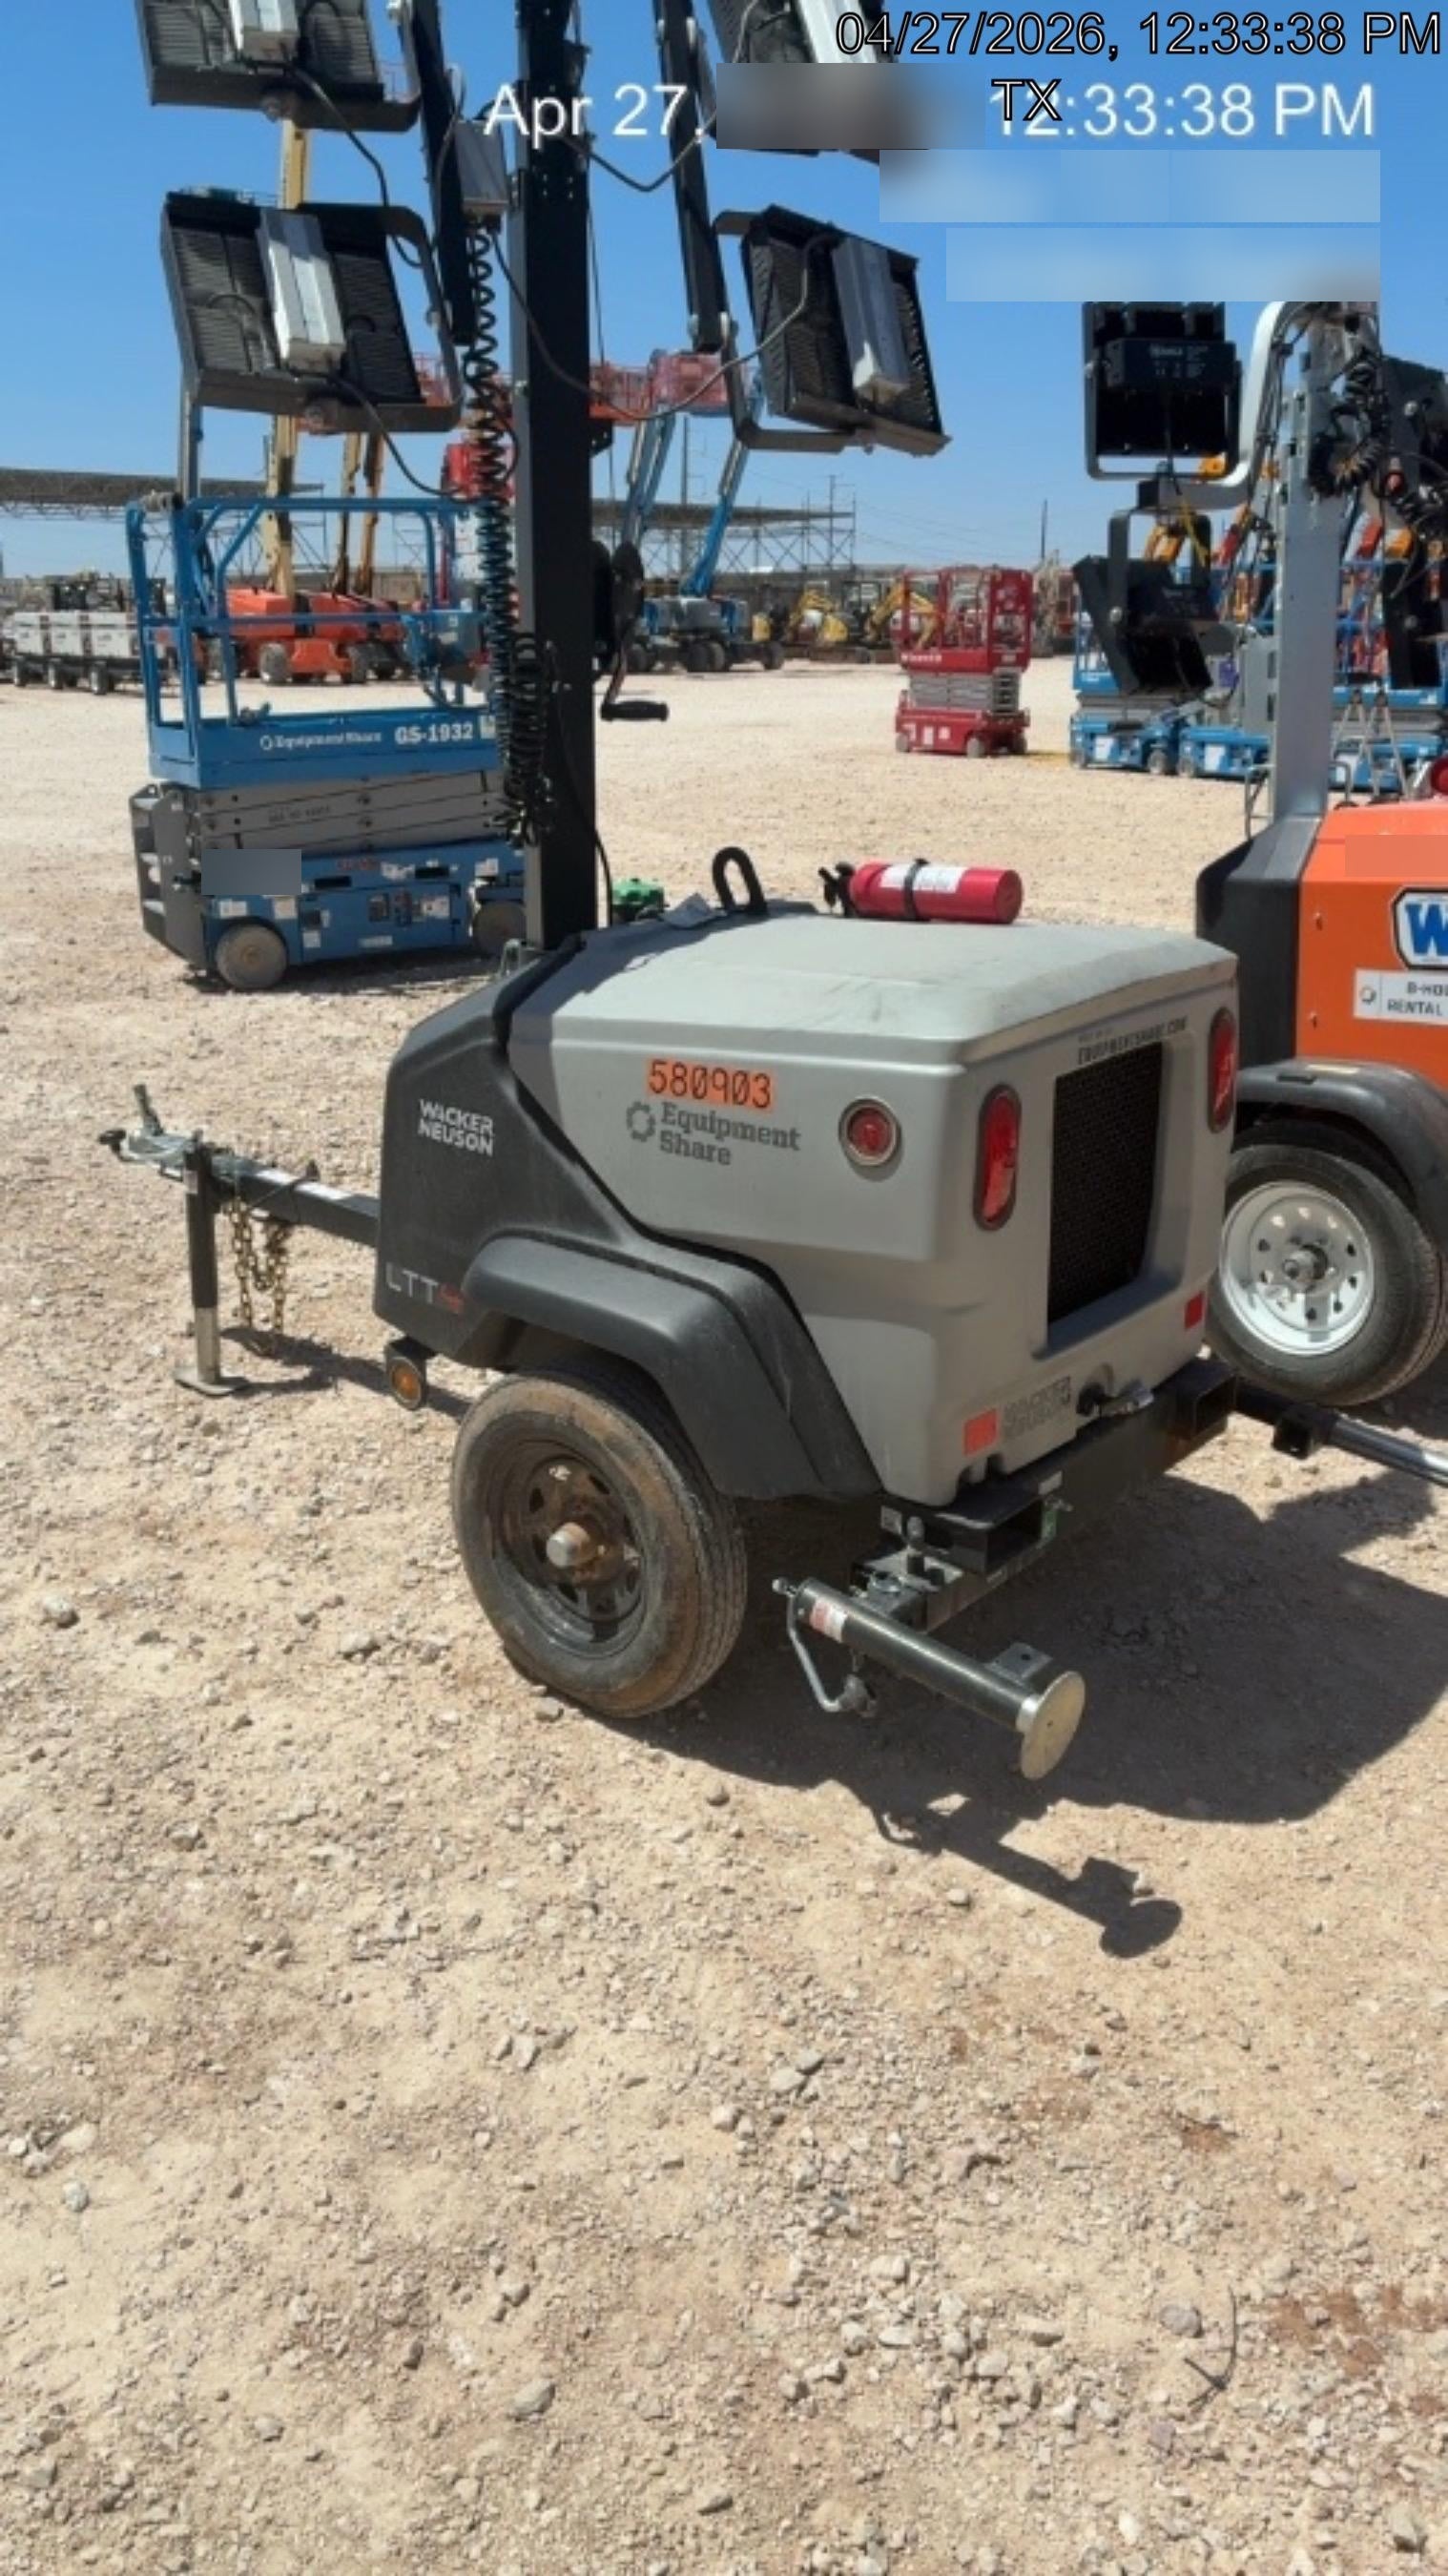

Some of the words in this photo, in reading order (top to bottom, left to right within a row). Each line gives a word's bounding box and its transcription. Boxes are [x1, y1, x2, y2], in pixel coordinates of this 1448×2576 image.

[394, 721, 474, 745] GS-1932
[1387, 998, 1443, 1017] RENTAL
[648, 1058, 773, 1110] 580903
[418, 1099, 495, 1135] WACKER
[661, 1101, 802, 1152] Equipment
[417, 1119, 495, 1157] NEUSON
[659, 1120, 733, 1166] Share
